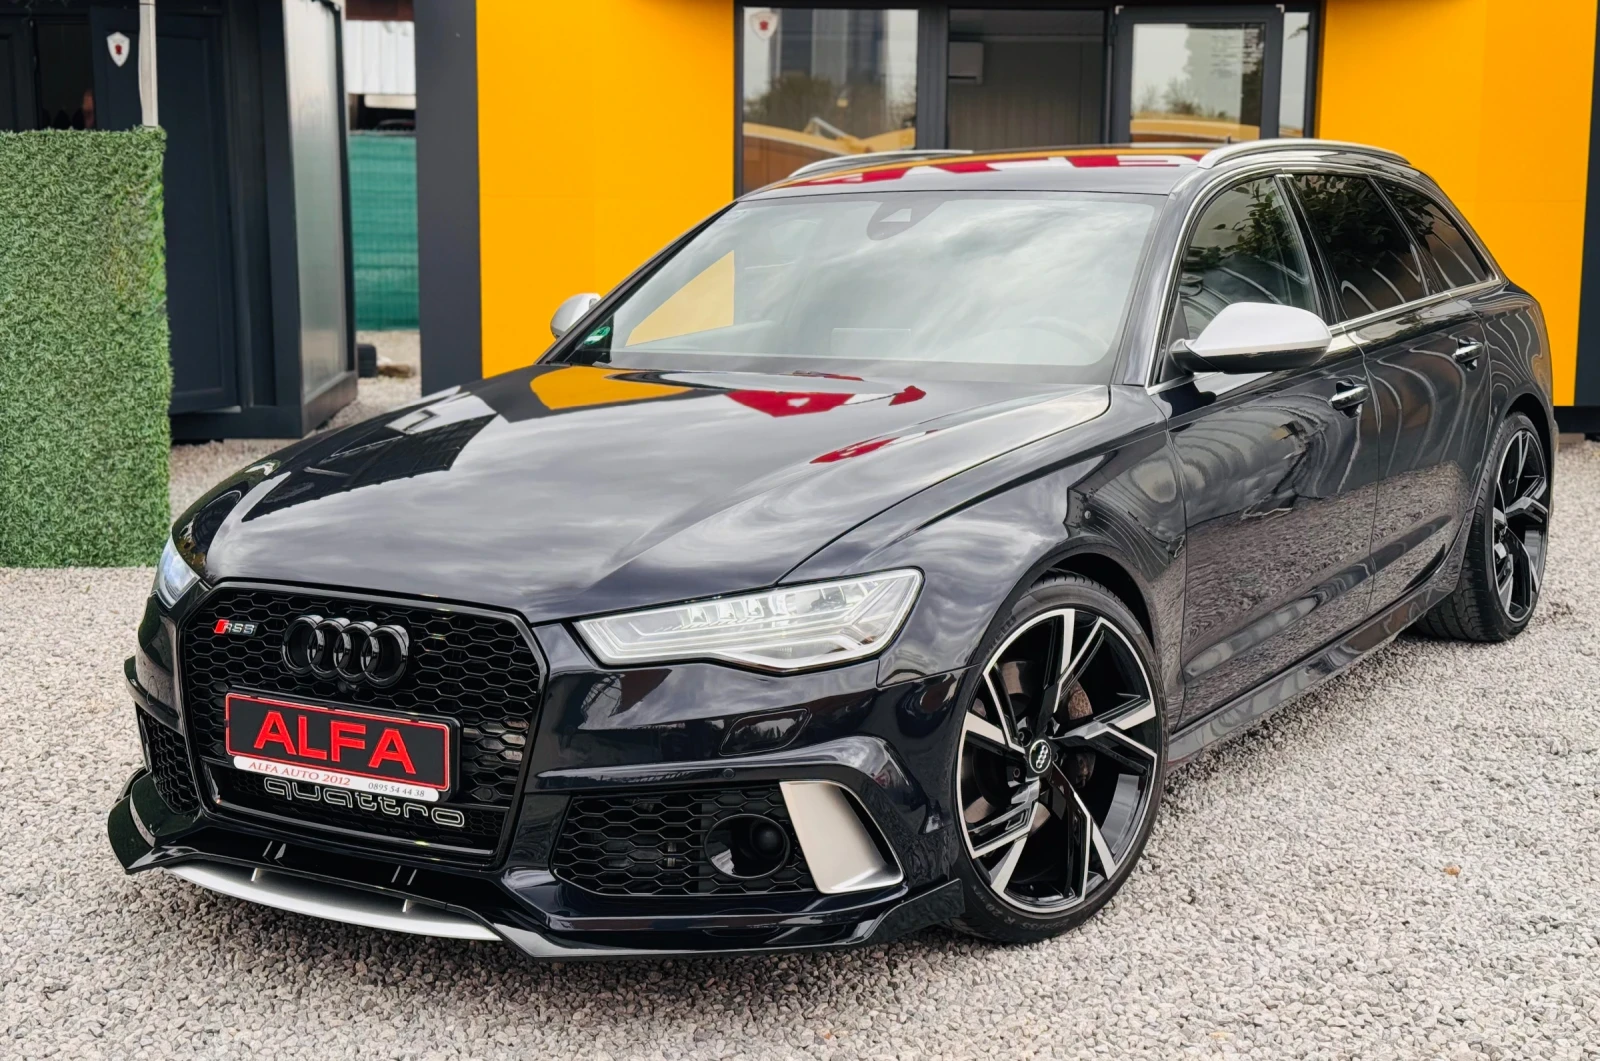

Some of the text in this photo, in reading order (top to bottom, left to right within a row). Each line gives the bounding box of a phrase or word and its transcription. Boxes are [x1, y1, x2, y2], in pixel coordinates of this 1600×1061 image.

[253, 710, 416, 775] ALFA
[248, 761, 351, 786] ALFA AUTO 2012
[368, 782, 388, 791] 0895
[390, 785, 400, 793] 54
[402, 788, 413, 796] 44
[263, 777, 465, 828] quattro
